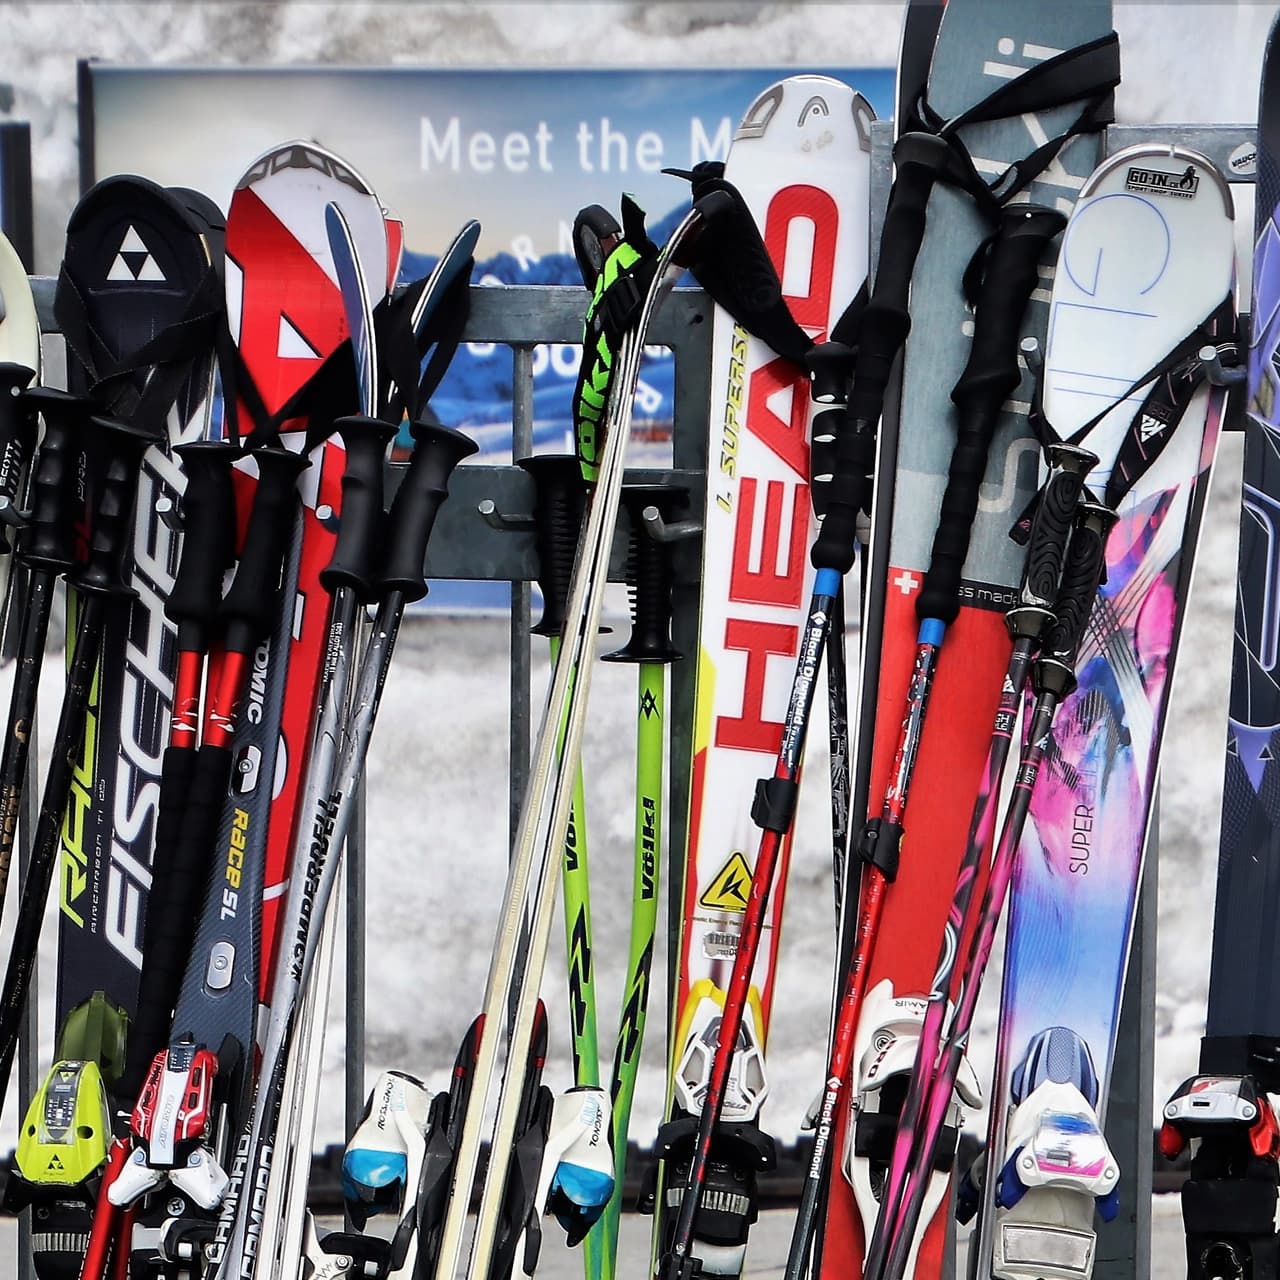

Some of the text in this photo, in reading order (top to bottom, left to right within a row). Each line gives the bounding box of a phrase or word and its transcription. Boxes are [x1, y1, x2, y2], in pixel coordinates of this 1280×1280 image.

[420, 117, 565, 172] Meet
[577, 116, 664, 172] the
[716, 185, 839, 751] HEAD
[805, 627, 824, 665] Black
[248, 640, 270, 725] TOMIC
[792, 667, 815, 725] Diamond
[640, 799, 658, 899] Völkl
[220, 889, 239, 920] SL
[809, 1091, 838, 1179] Black Diamond
